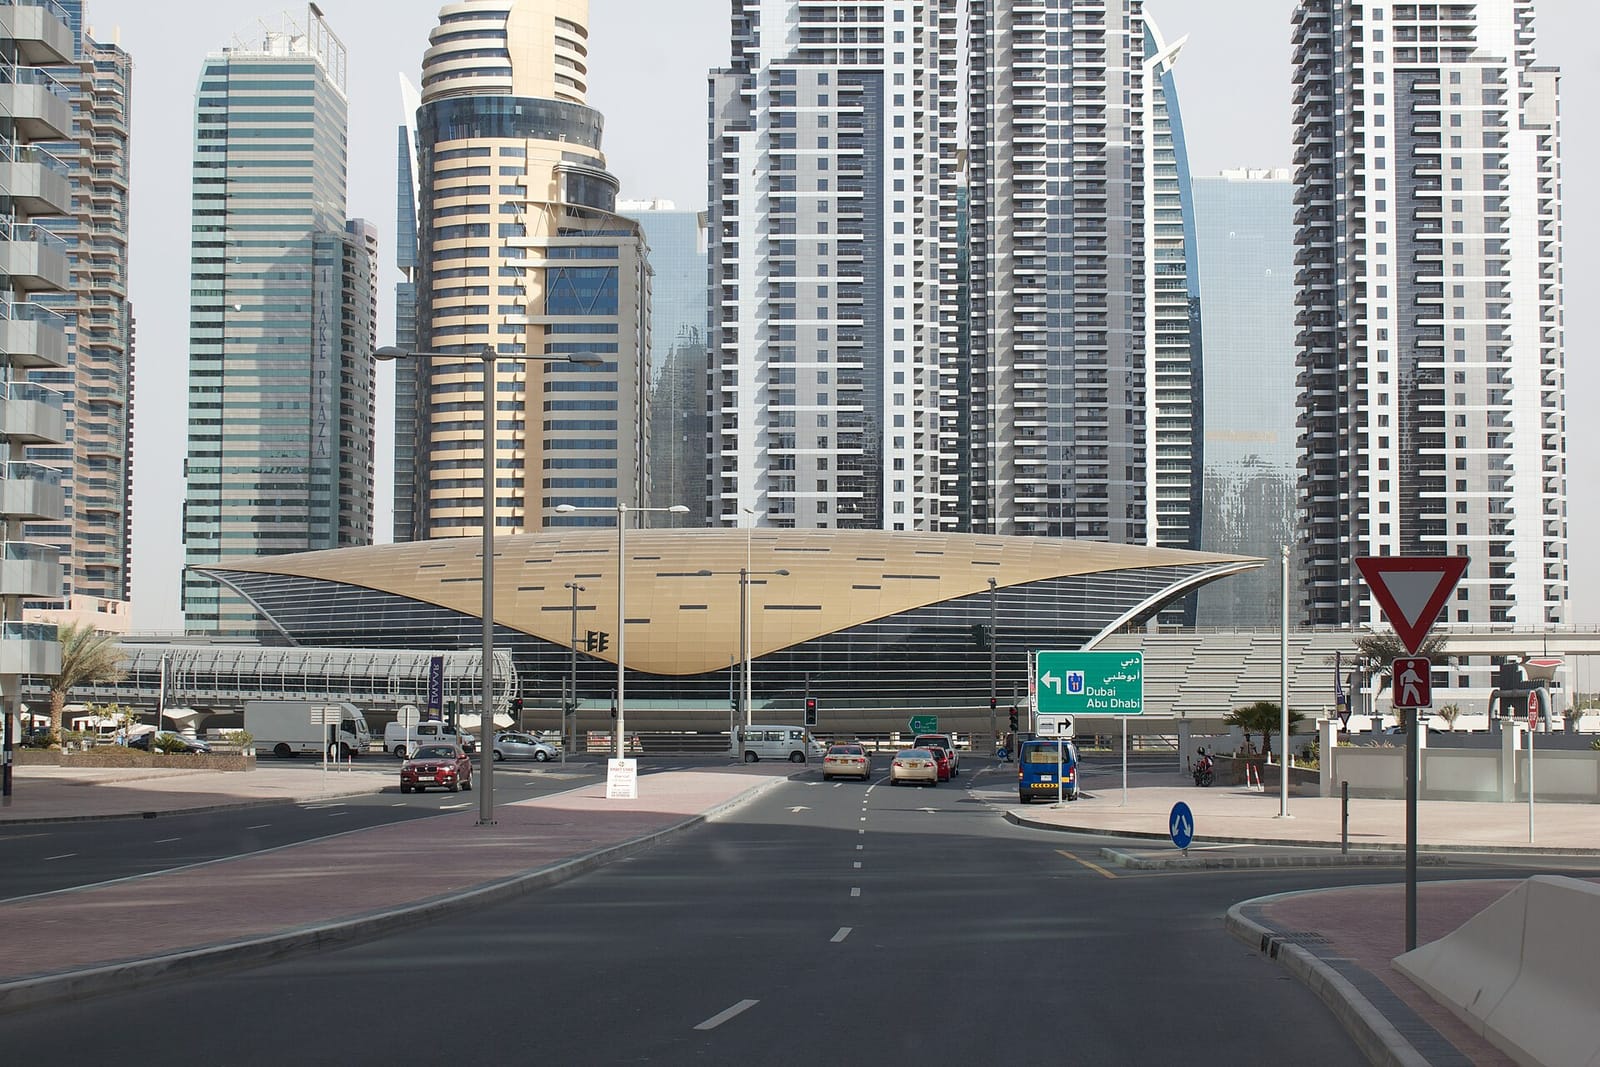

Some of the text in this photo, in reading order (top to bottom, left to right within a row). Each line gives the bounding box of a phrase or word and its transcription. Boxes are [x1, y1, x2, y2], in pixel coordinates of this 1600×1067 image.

[316, 268, 328, 456] 1 LAKE PLAZA
[1120, 657, 1140, 670] دبي
[1086, 686, 1116, 697] Dubai
[1086, 697, 1140, 709] Abu Dhabi
